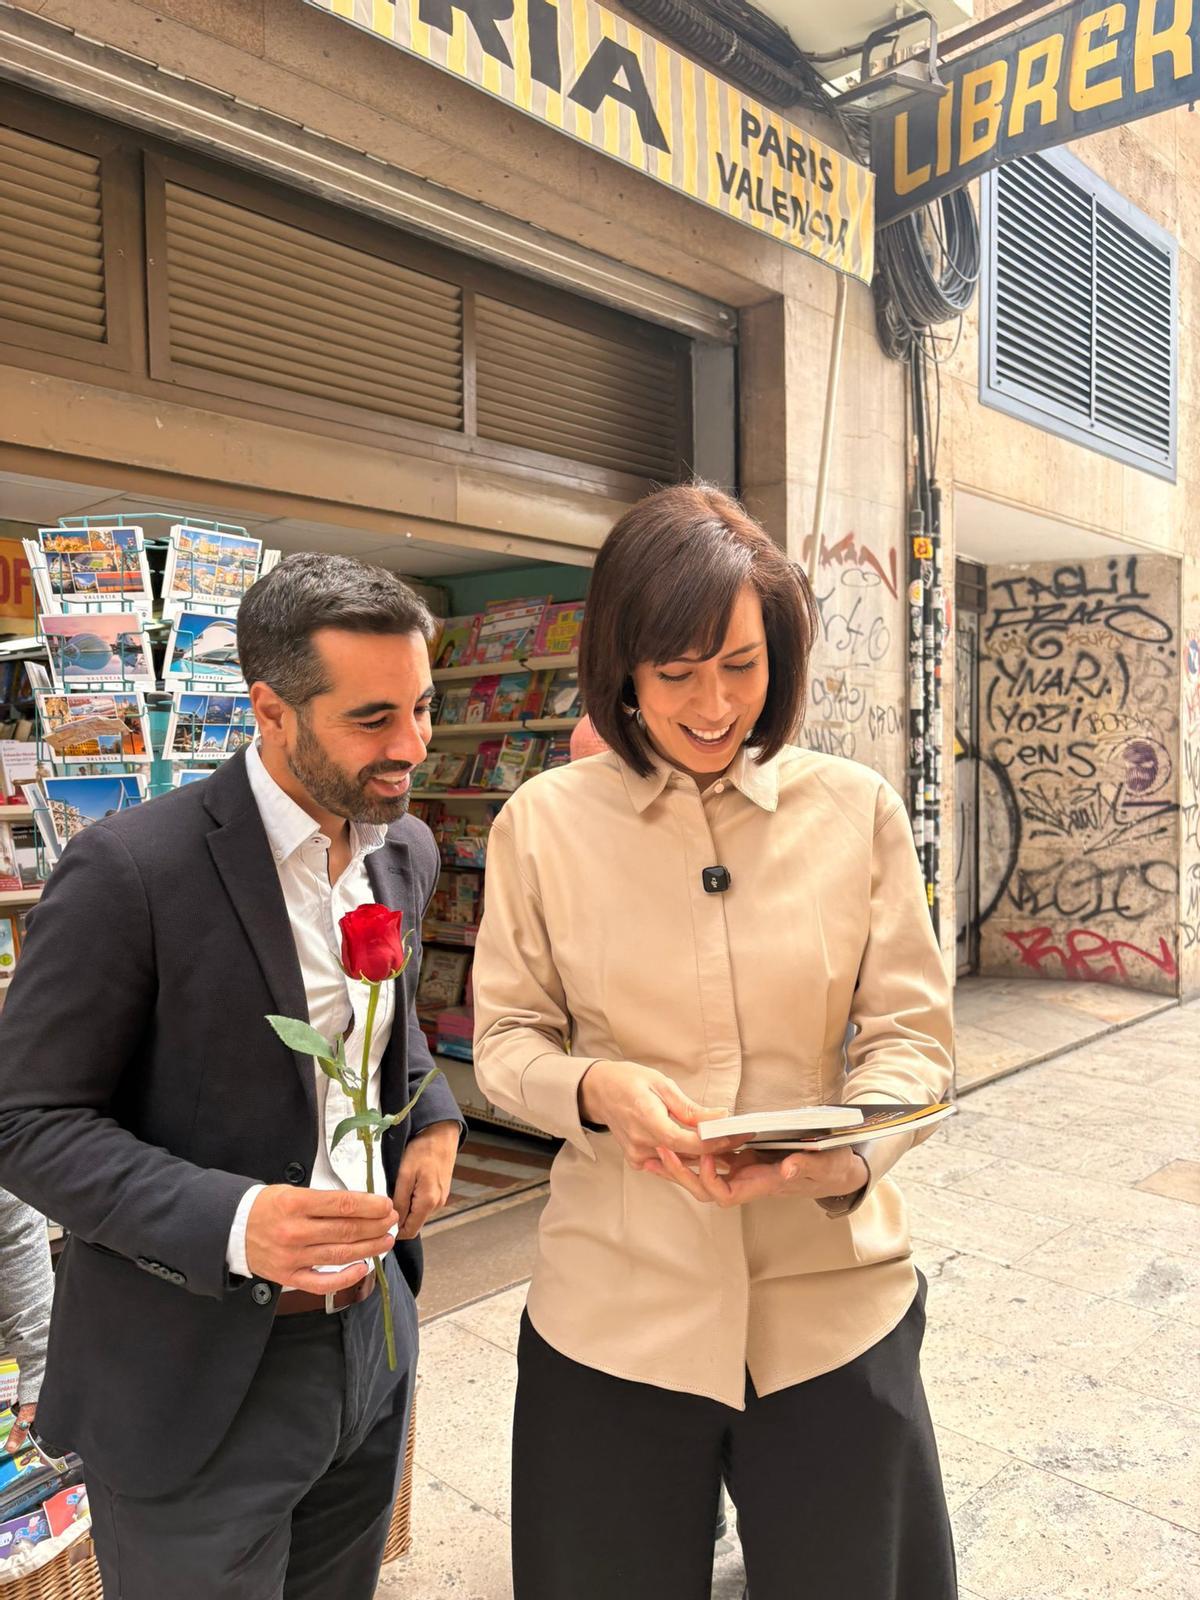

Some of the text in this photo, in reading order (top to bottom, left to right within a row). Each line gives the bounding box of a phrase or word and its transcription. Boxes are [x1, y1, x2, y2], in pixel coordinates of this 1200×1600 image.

[386, 0, 672, 154] RIA
[740, 108, 834, 193] PARIS
[893, 0, 1194, 196] LIBRER
